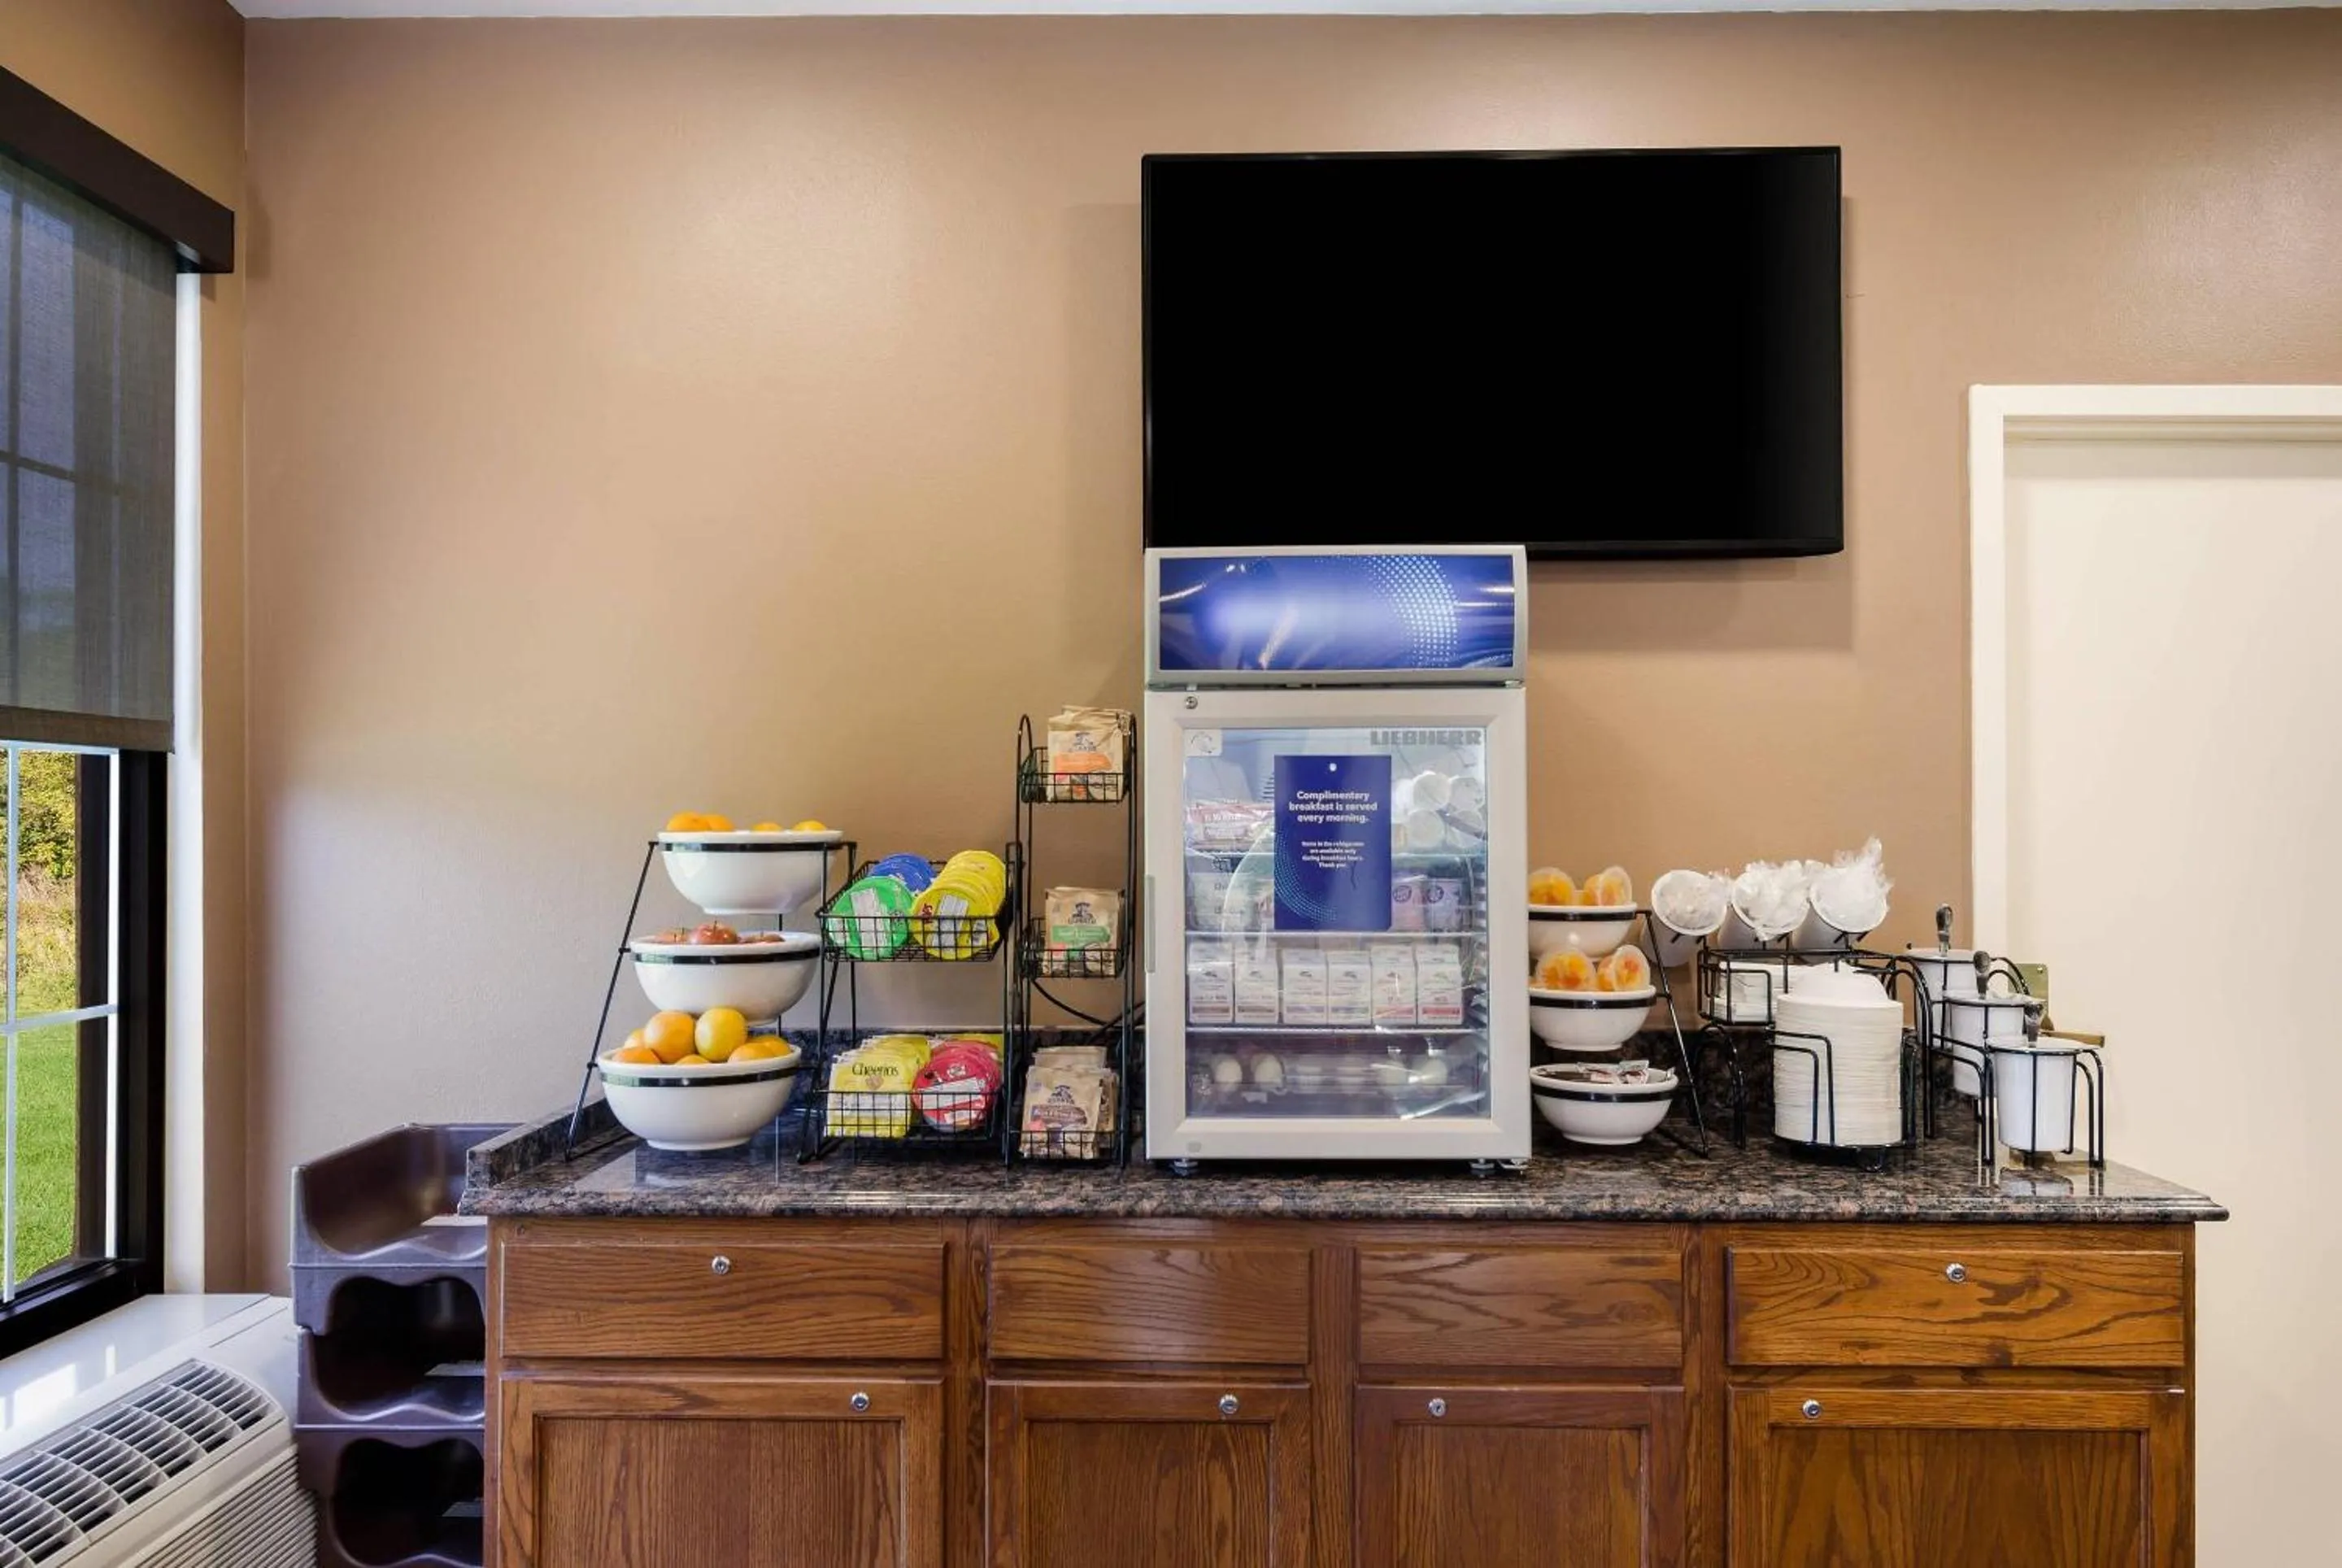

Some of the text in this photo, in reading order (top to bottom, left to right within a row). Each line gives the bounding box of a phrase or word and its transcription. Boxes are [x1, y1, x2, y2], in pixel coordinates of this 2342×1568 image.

[1371, 730, 1482, 746] LIEBHERR
[1296, 791, 1369, 801] Complimentary
[1289, 802, 1378, 812] breakfast is served
[1297, 813, 1369, 824] every morning.
[851, 1061, 899, 1078] Cheerios
